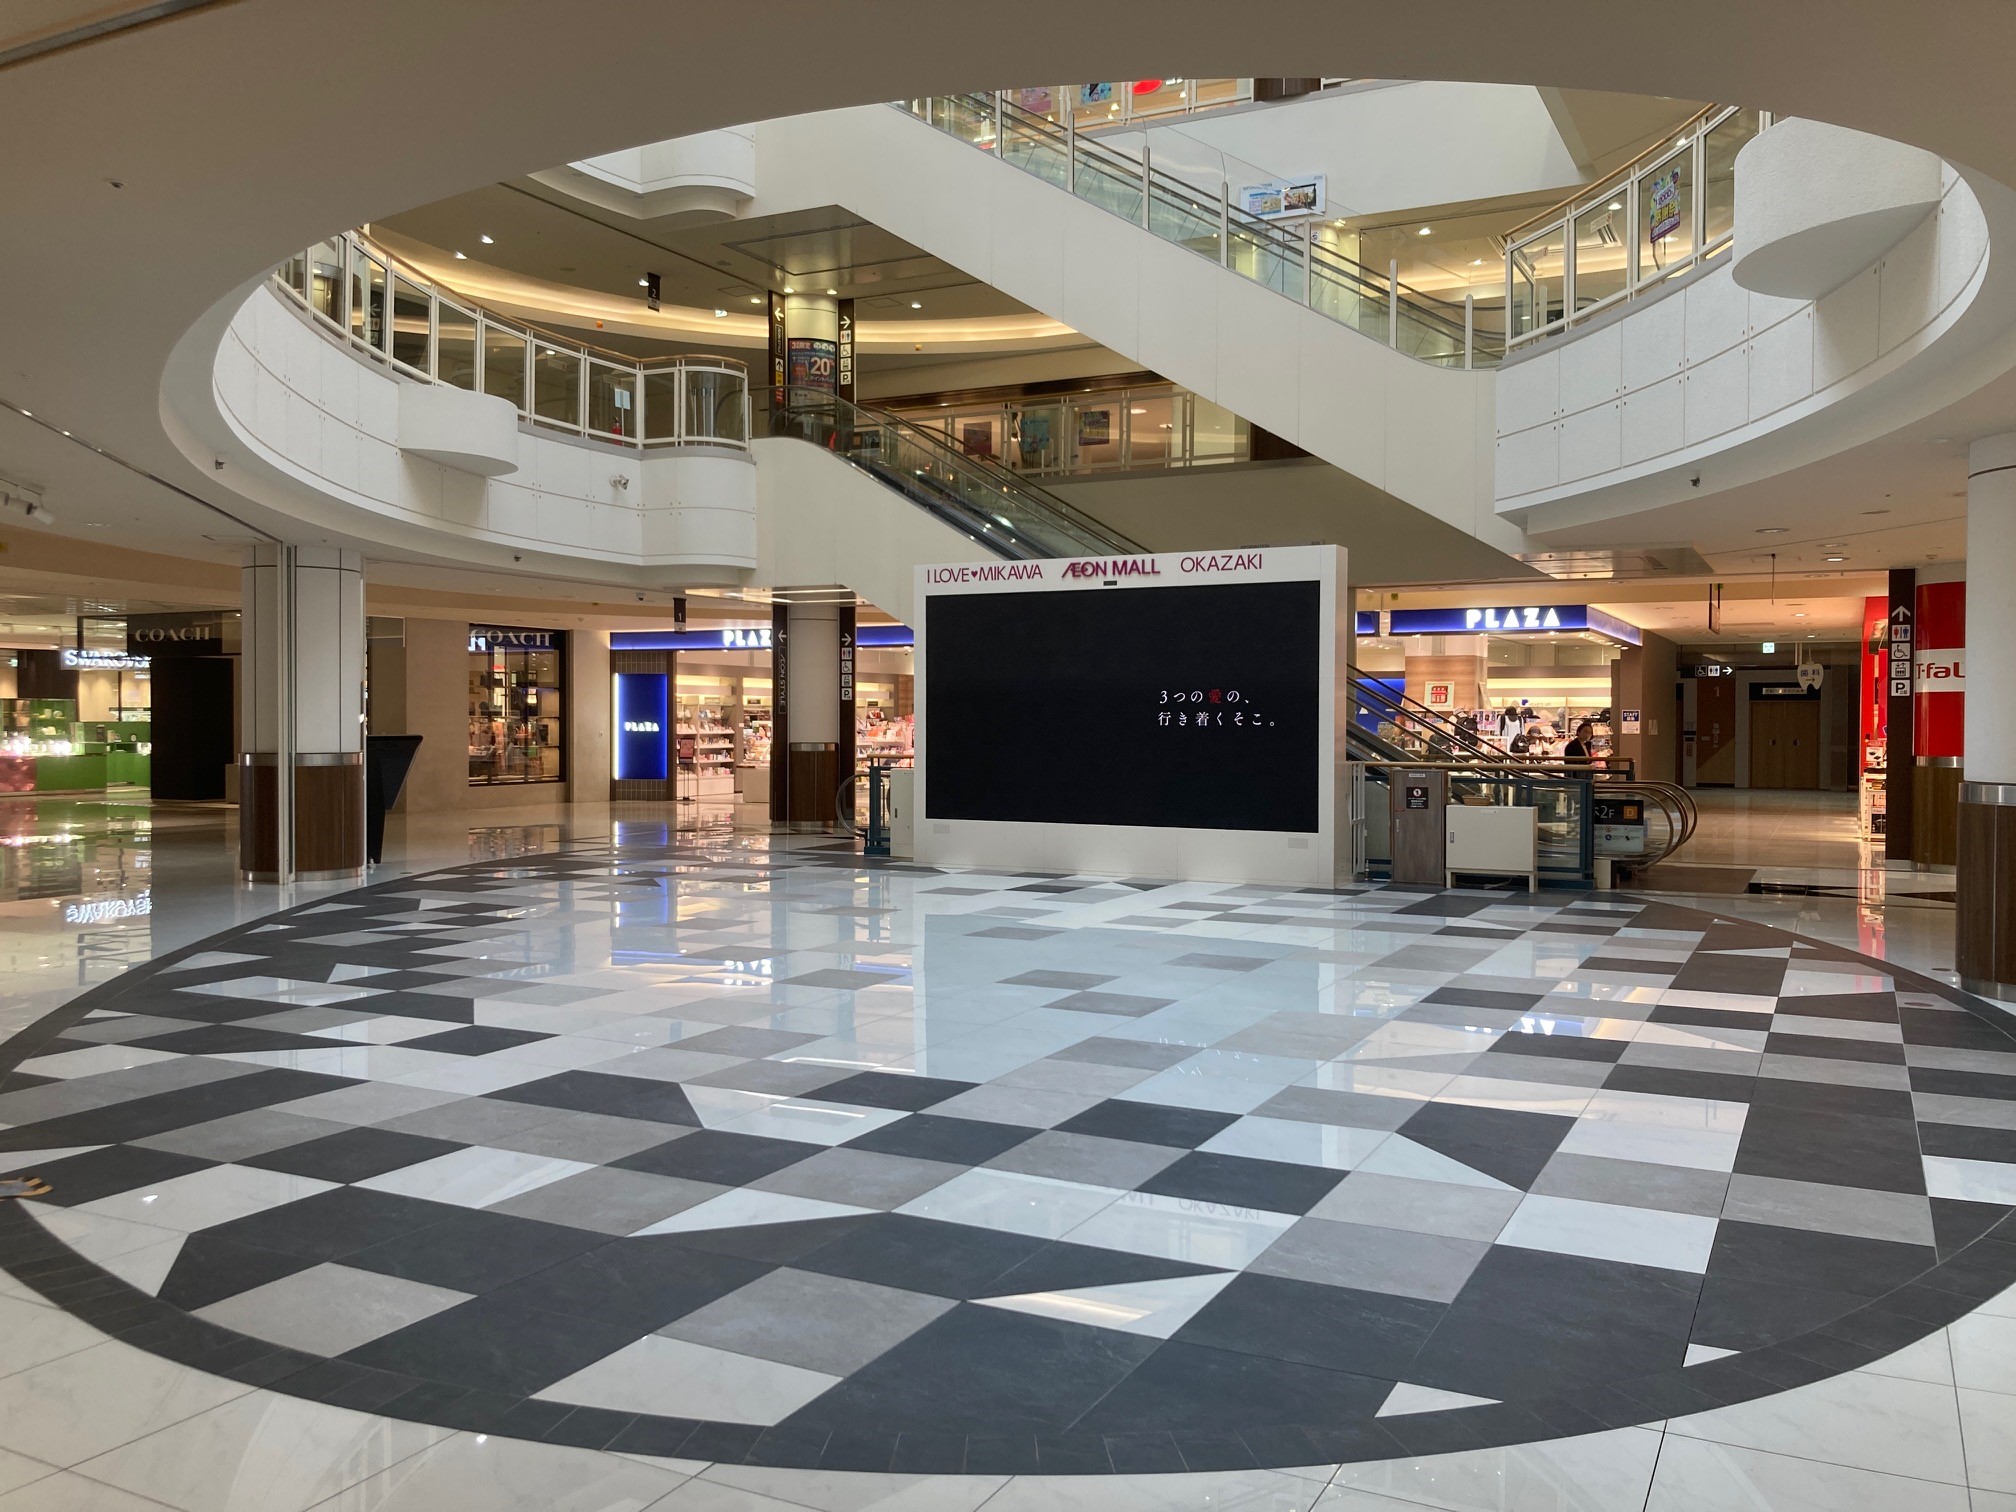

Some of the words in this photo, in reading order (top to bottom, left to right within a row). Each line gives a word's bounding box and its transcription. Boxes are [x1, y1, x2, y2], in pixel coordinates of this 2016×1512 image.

[934, 568, 970, 583] LOVE
[979, 564, 1043, 581] MIKAWA
[1112, 558, 1161, 576] MALL
[1180, 554, 1262, 573] OKAZAKI
[1466, 607, 1560, 628] PLAZA
[135, 626, 210, 642] COACH
[470, 629, 553, 646] COACH
[1916, 662, 1965, 679] T-fal
[1160, 689, 1249, 704] 3つの愛の、
[624, 721, 660, 732] PLAZA
[1158, 712, 1274, 726] 行き着くそこ。
[1600, 806, 1615, 818] 2F
